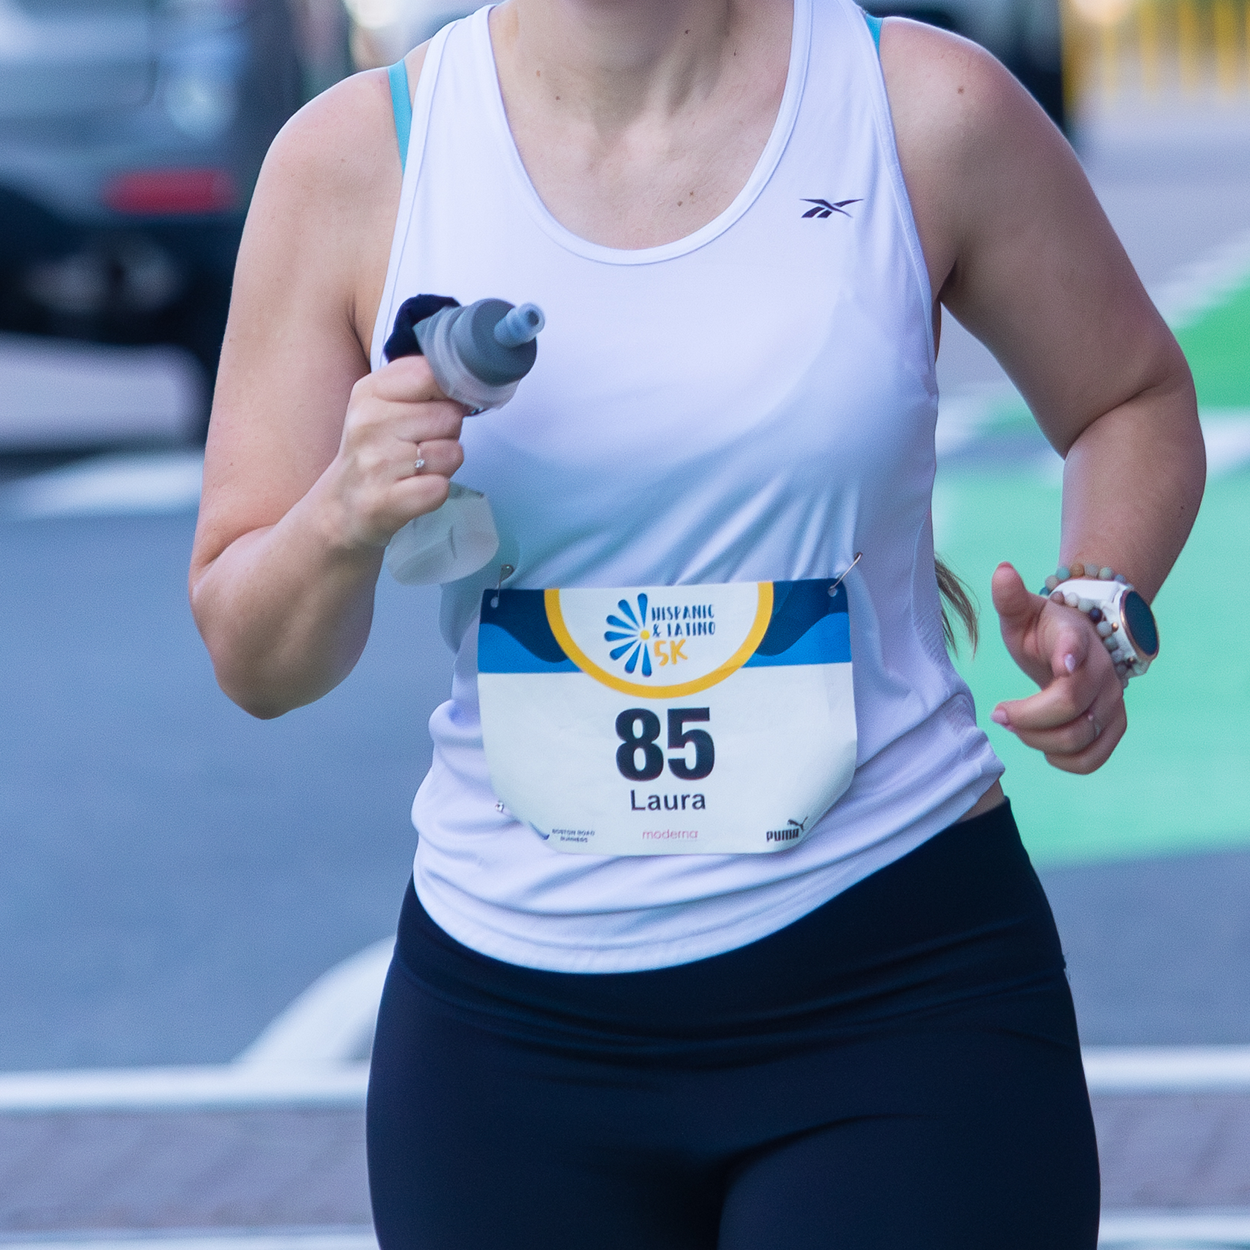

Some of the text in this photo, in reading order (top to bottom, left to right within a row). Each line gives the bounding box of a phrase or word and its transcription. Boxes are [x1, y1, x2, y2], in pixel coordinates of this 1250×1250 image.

[651, 603, 715, 621] HISPANIC
[652, 621, 716, 638] & LATINO
[653, 638, 688, 667] 5K
[615, 707, 715, 782] 85
[630, 790, 706, 812] Laura
[642, 829, 699, 840] moderna
[765, 827, 800, 843] PUMA
